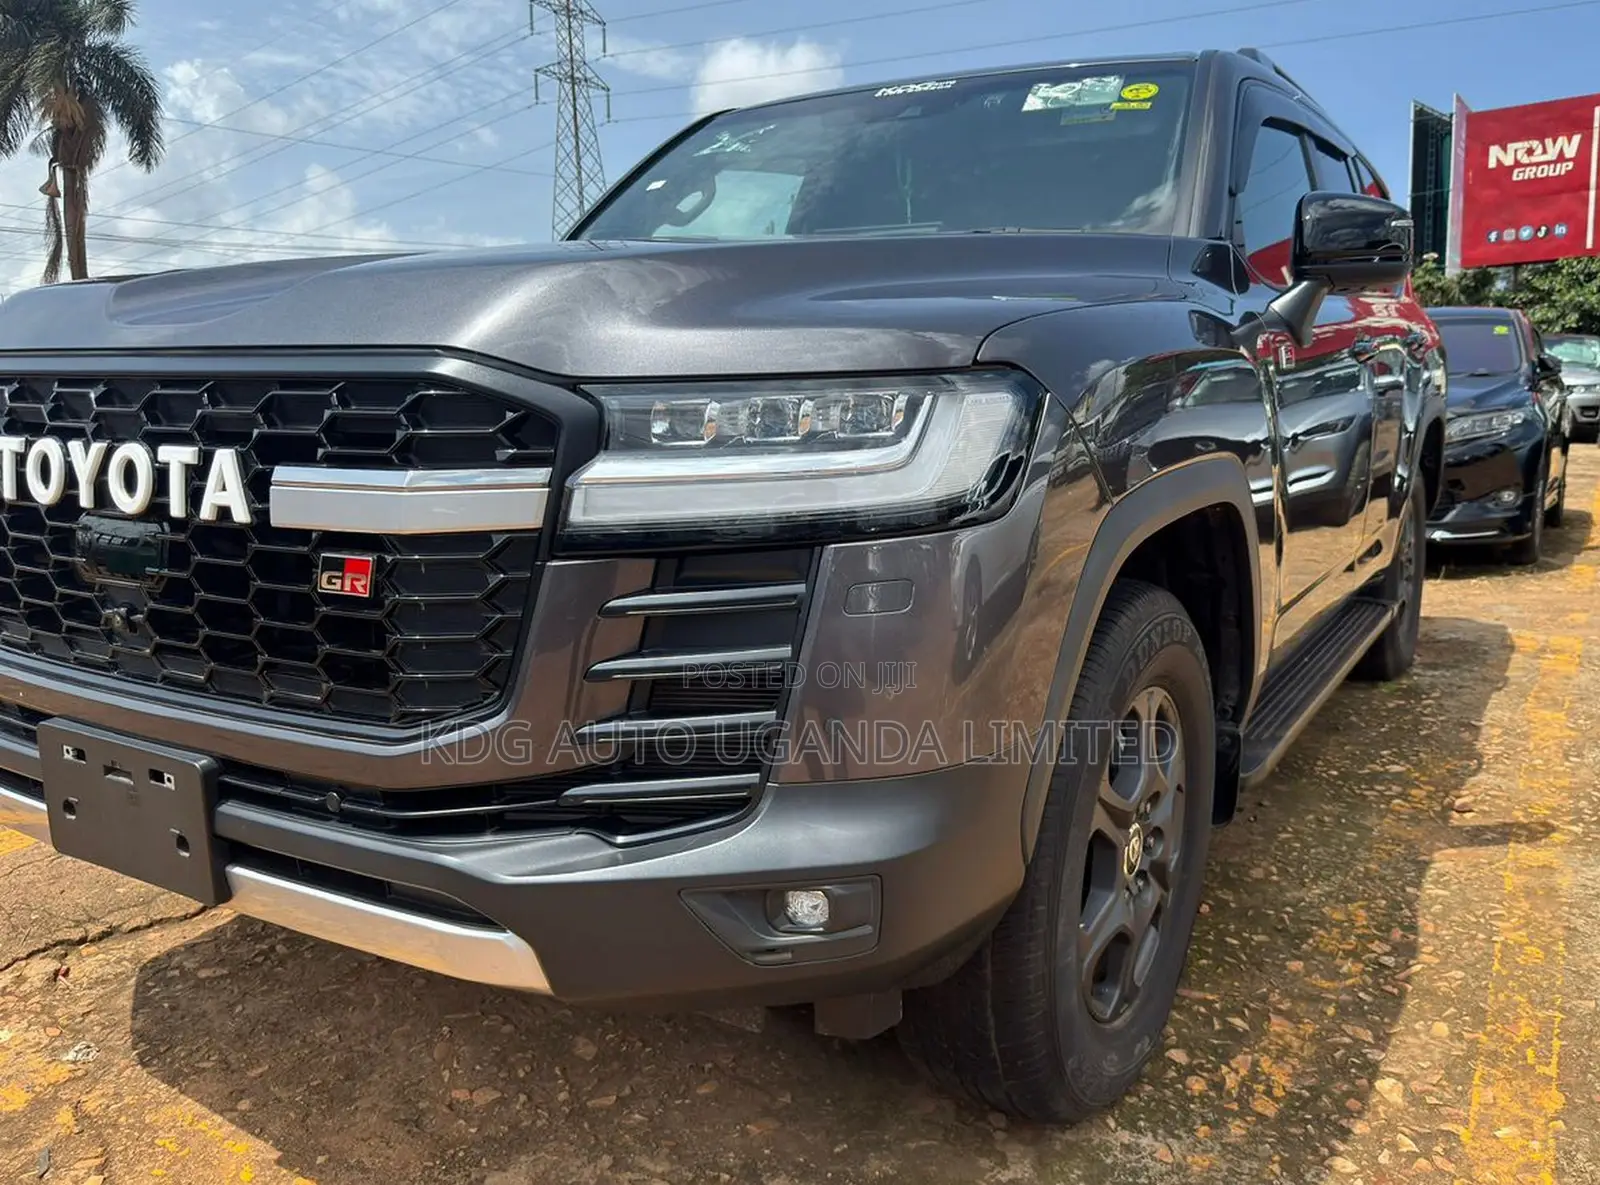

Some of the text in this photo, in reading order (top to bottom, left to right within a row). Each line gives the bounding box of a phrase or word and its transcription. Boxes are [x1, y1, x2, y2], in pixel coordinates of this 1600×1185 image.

[1487, 133, 1582, 169] NOW
[1511, 161, 1574, 181] GROUP
[0, 435, 251, 523] TOYOTA
[320, 570, 368, 594] GR
